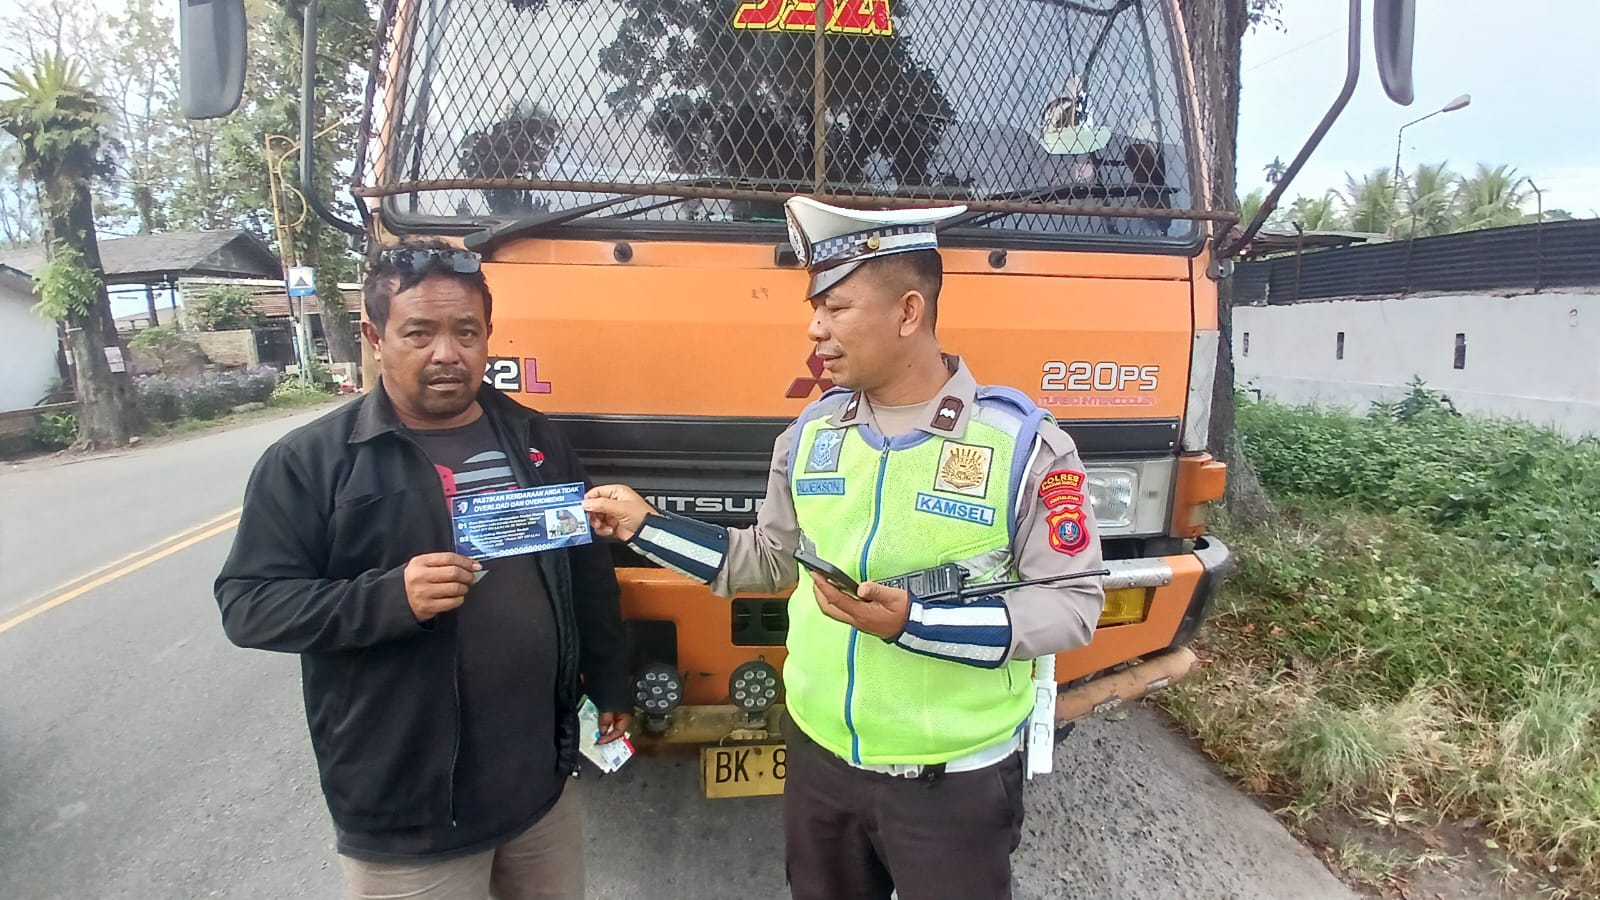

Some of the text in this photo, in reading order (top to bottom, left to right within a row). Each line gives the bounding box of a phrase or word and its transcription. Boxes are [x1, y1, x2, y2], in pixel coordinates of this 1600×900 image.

[1041, 360, 1160, 391] 220PS
[505, 489, 544, 501] KENDARAAN
[561, 486, 580, 494] TIDAK
[473, 502, 510, 513] OVERLOAD
[919, 496, 990, 523] KAMSEL
[715, 749, 750, 784] BK
